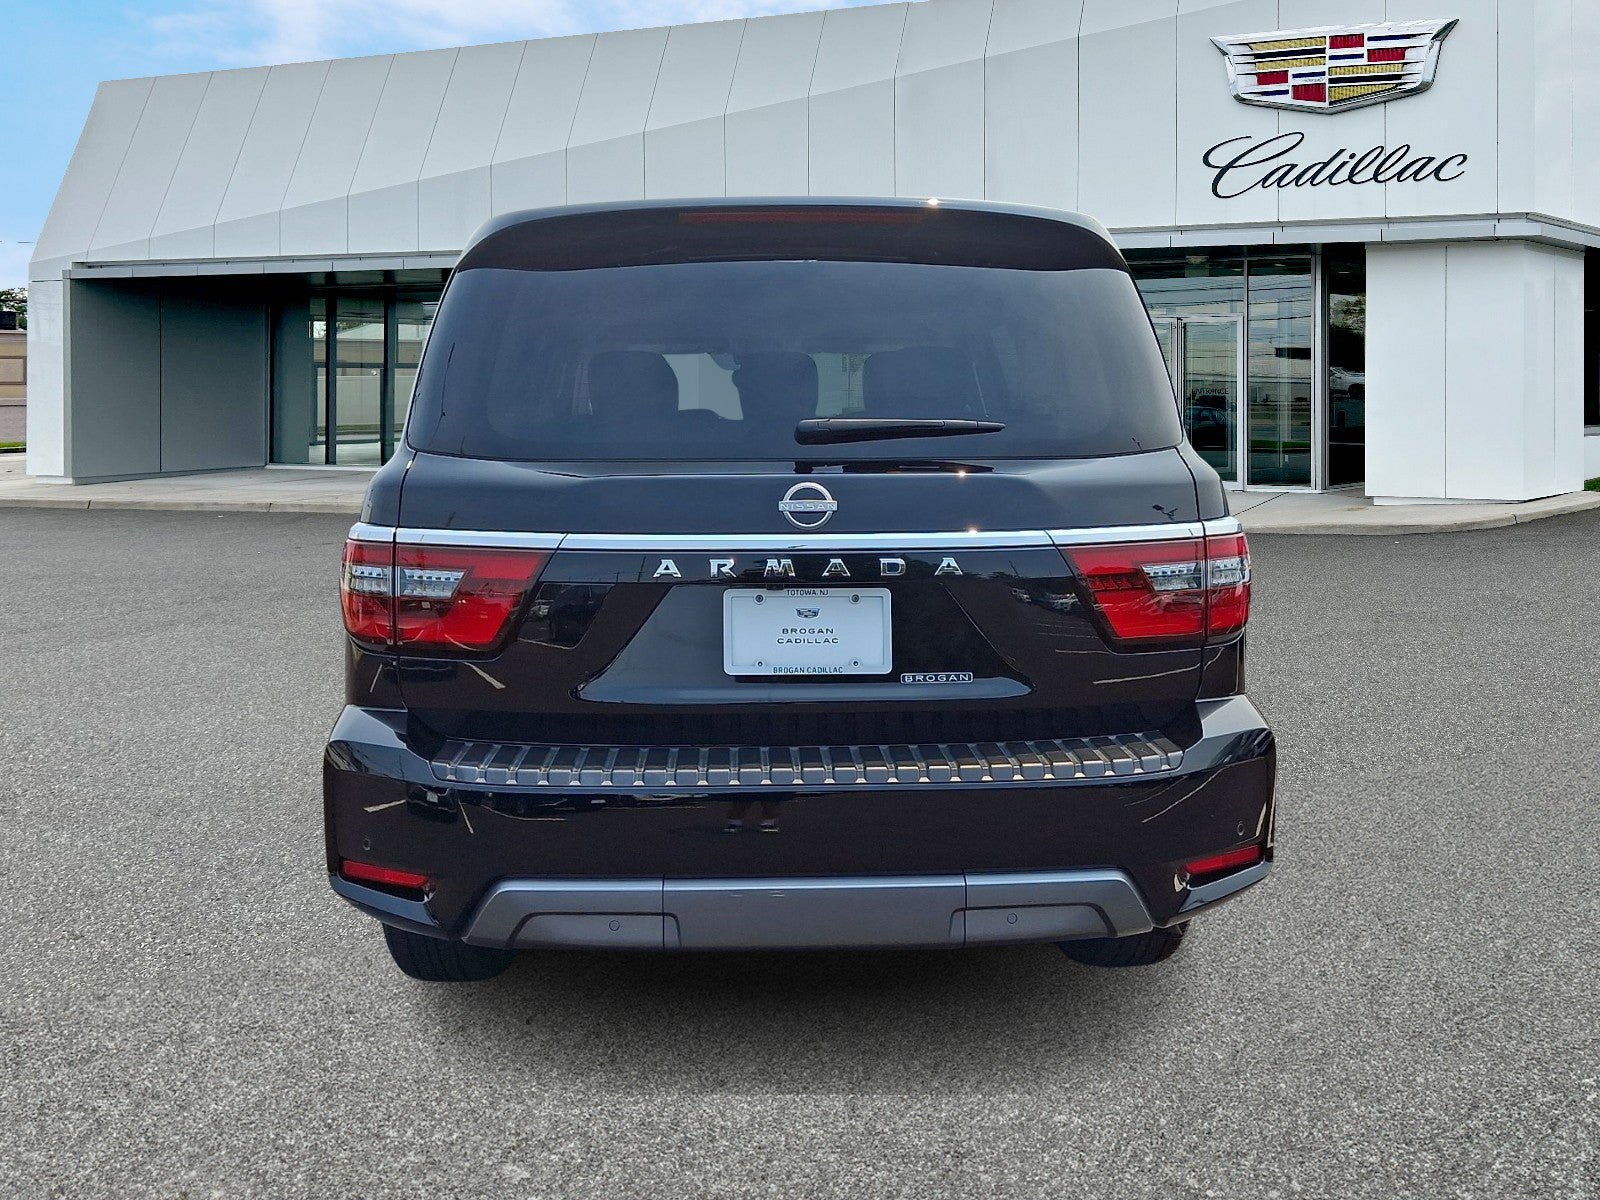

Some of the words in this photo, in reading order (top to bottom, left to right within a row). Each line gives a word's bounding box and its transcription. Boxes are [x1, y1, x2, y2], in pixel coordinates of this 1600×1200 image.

[1202, 131, 1468, 199] Cadillac
[652, 557, 963, 577] ARMADA
[773, 666, 805, 674] BROGAN
[806, 666, 844, 674] CADILLAC
[905, 674, 969, 683] BROGAN
